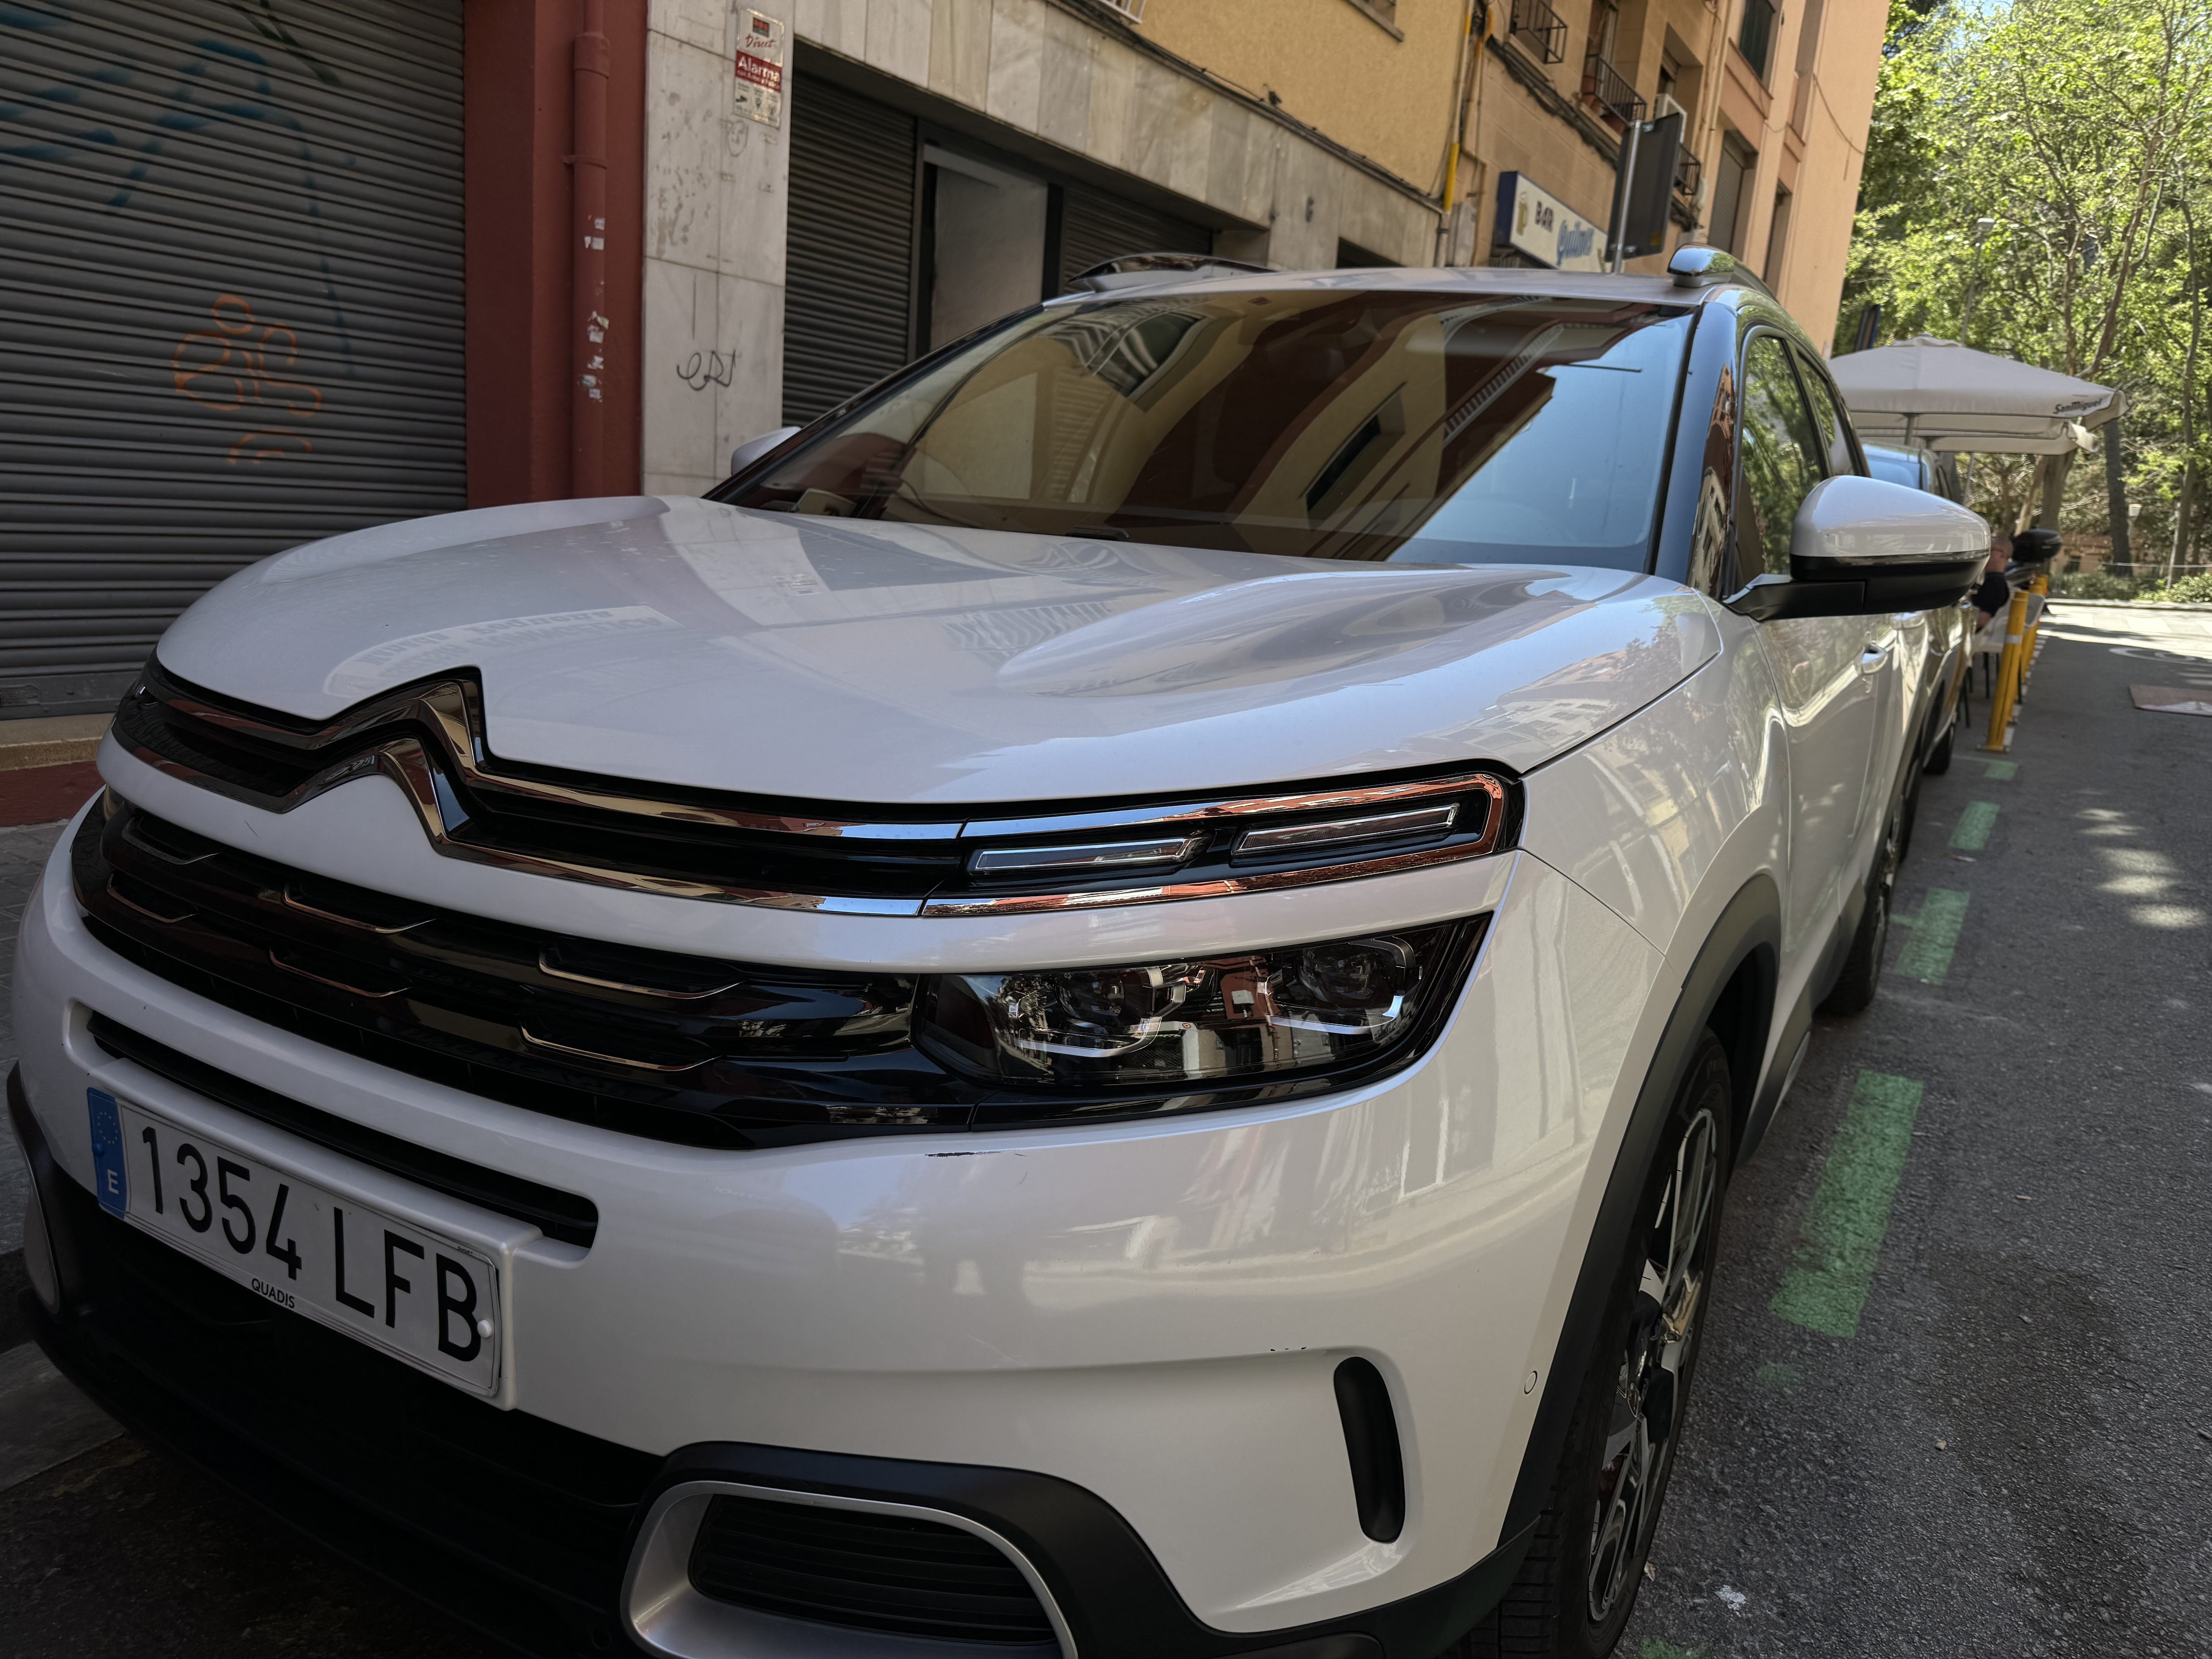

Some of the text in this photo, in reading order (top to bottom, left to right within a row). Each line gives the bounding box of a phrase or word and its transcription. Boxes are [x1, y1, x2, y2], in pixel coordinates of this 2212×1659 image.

[738, 55, 780, 81] Alarma
[1535, 201, 1555, 233] BAR
[107, 1169, 120, 1195] E
[142, 1126, 481, 1362] 1354 LFB
[252, 1278, 295, 1309] QUADIS
